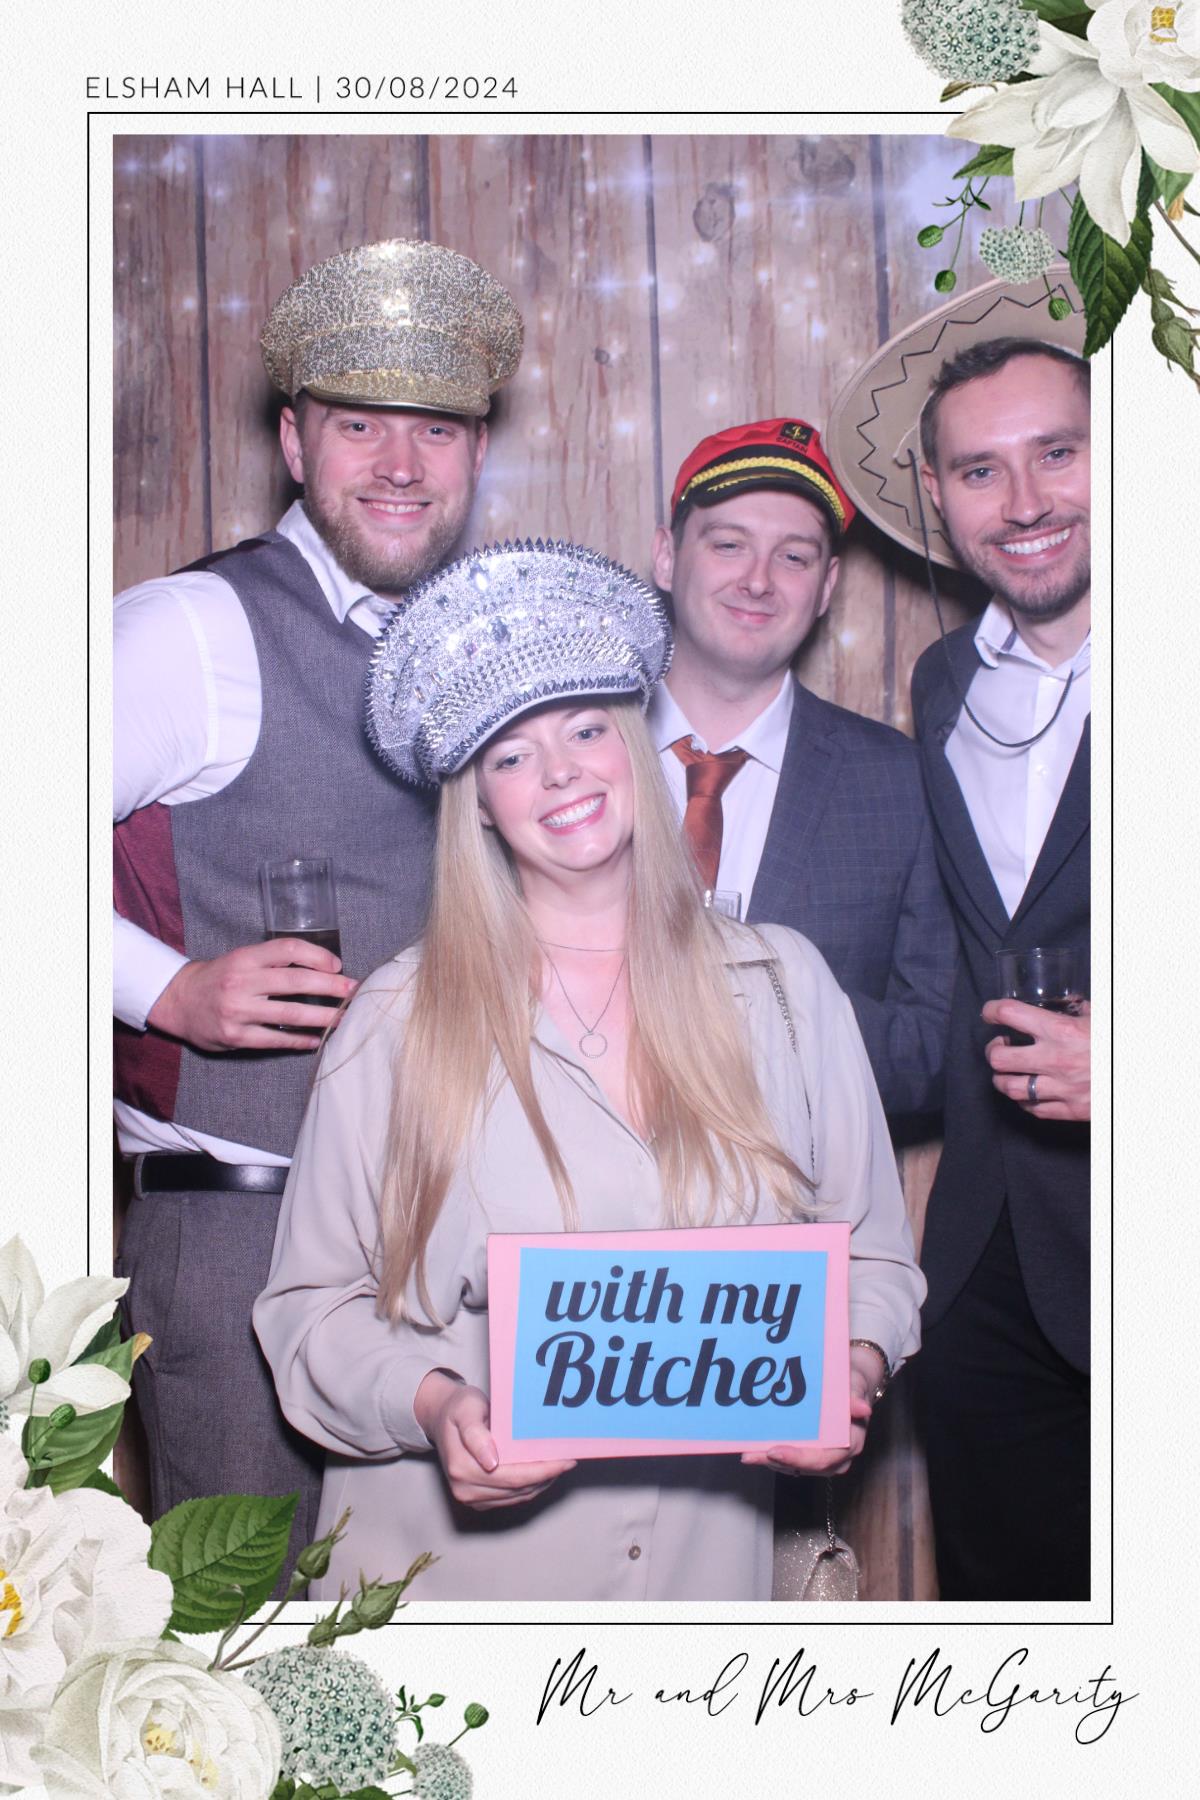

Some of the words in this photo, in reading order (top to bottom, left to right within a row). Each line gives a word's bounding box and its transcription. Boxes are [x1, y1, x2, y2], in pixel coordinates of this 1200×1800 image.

[775, 436, 808, 454] CAPTAIN
[544, 1264, 684, 1324] with
[700, 1283, 802, 1344] my
[535, 1330, 807, 1408] Bitches
